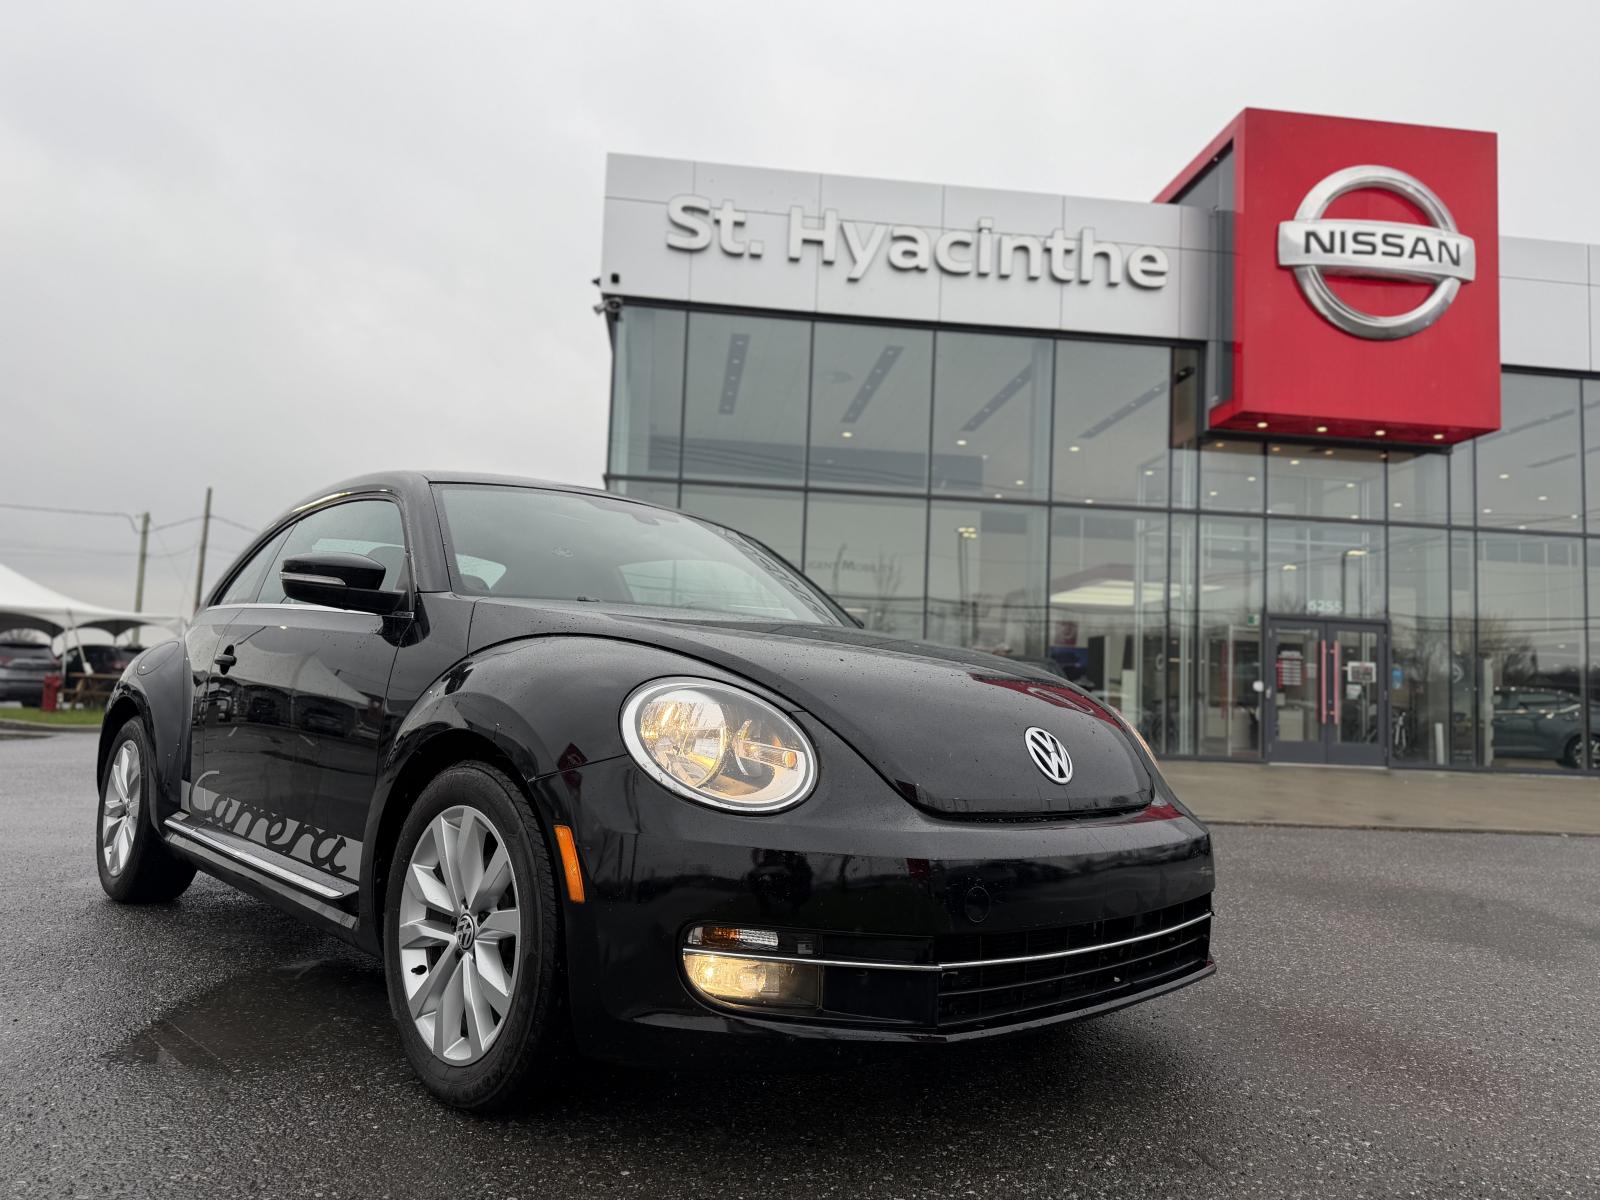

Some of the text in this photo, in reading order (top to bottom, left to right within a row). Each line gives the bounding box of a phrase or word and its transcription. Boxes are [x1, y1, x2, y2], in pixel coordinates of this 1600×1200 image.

[665, 194, 1169, 289] St. Hyacinthe
[1304, 230, 1461, 266] NISSAN
